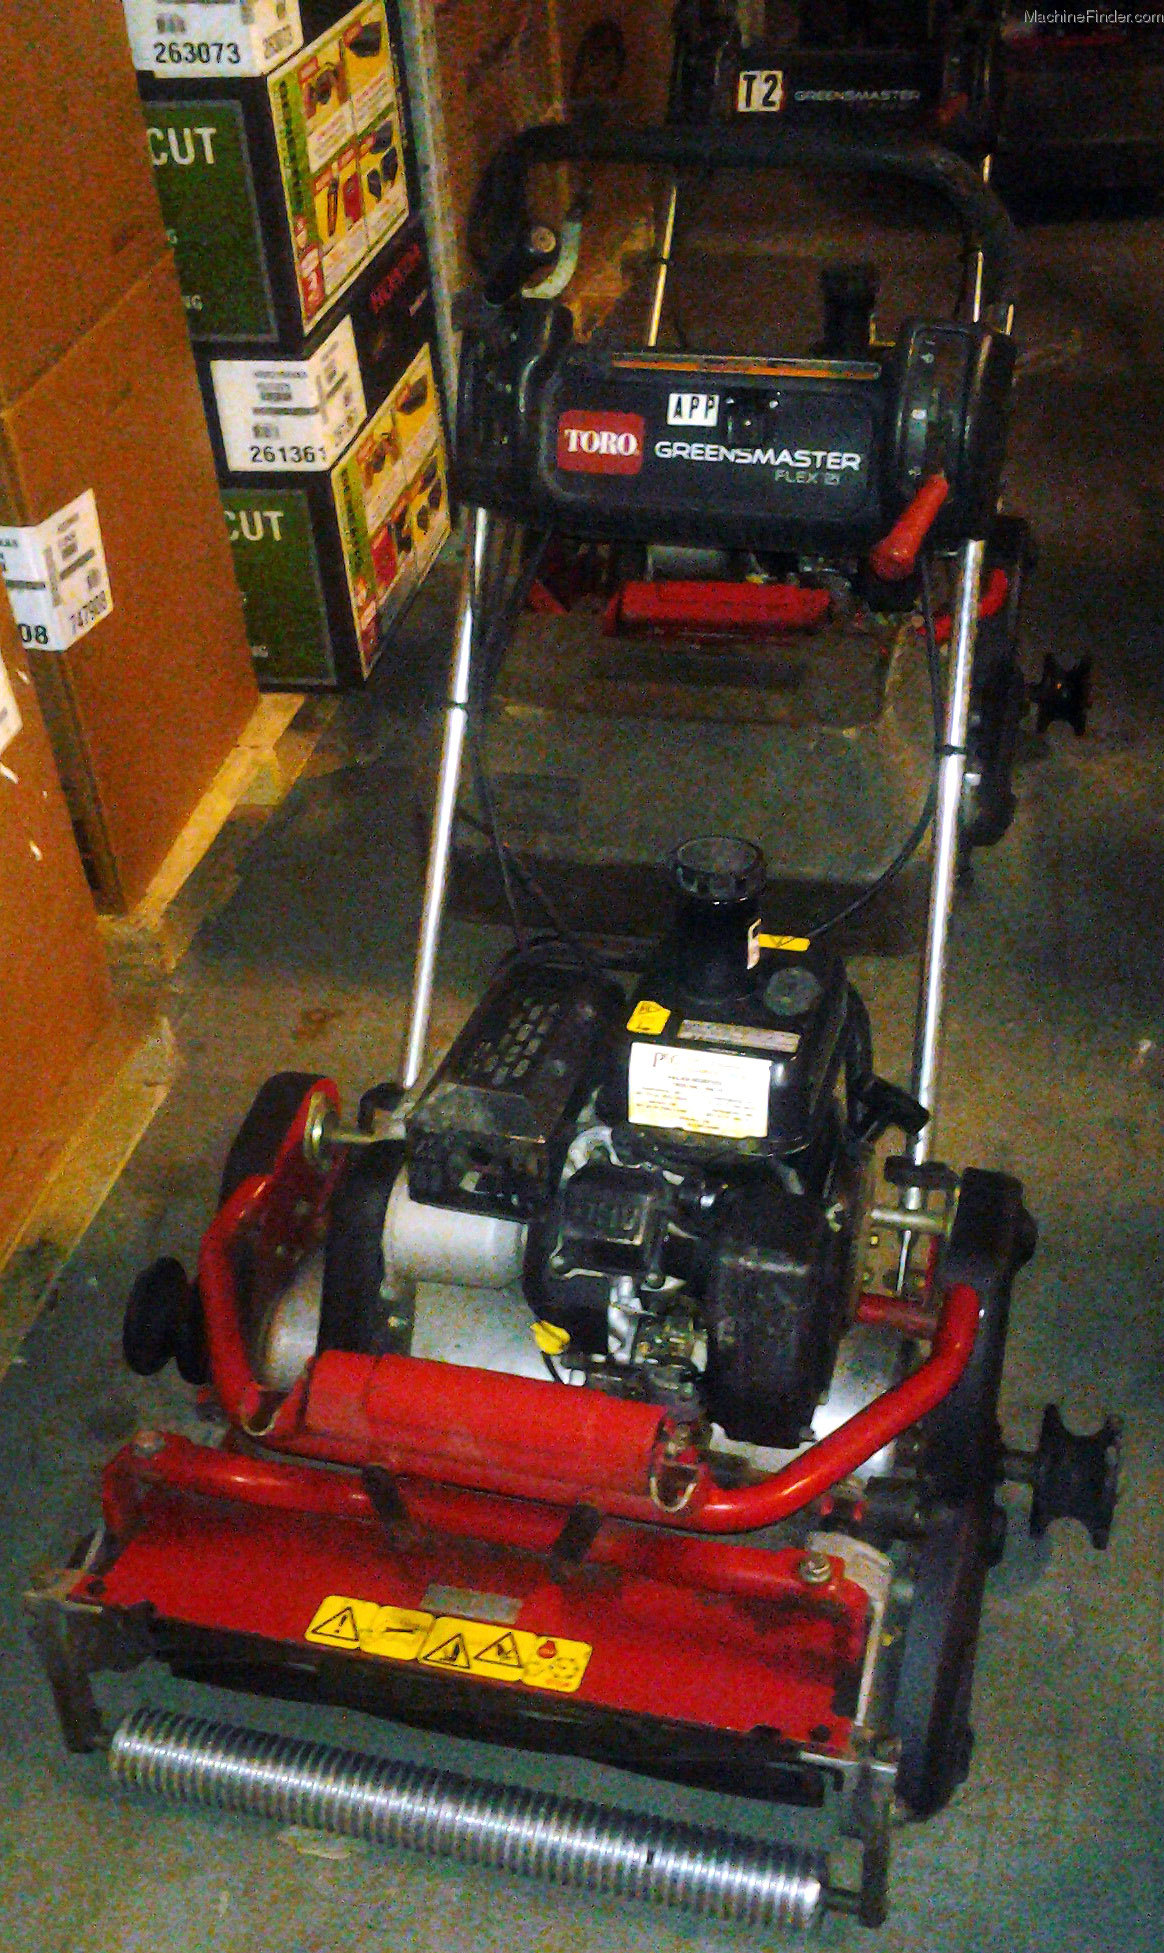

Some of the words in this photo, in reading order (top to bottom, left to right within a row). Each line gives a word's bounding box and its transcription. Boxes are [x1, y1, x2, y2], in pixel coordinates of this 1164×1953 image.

[153, 42, 241, 64] 263073
[743, 74, 778, 108] T2
[146, 127, 217, 166] CUT
[249, 445, 327, 463] 261361
[564, 428, 638, 456] TORO
[654, 441, 861, 471] GREENSMASTER
